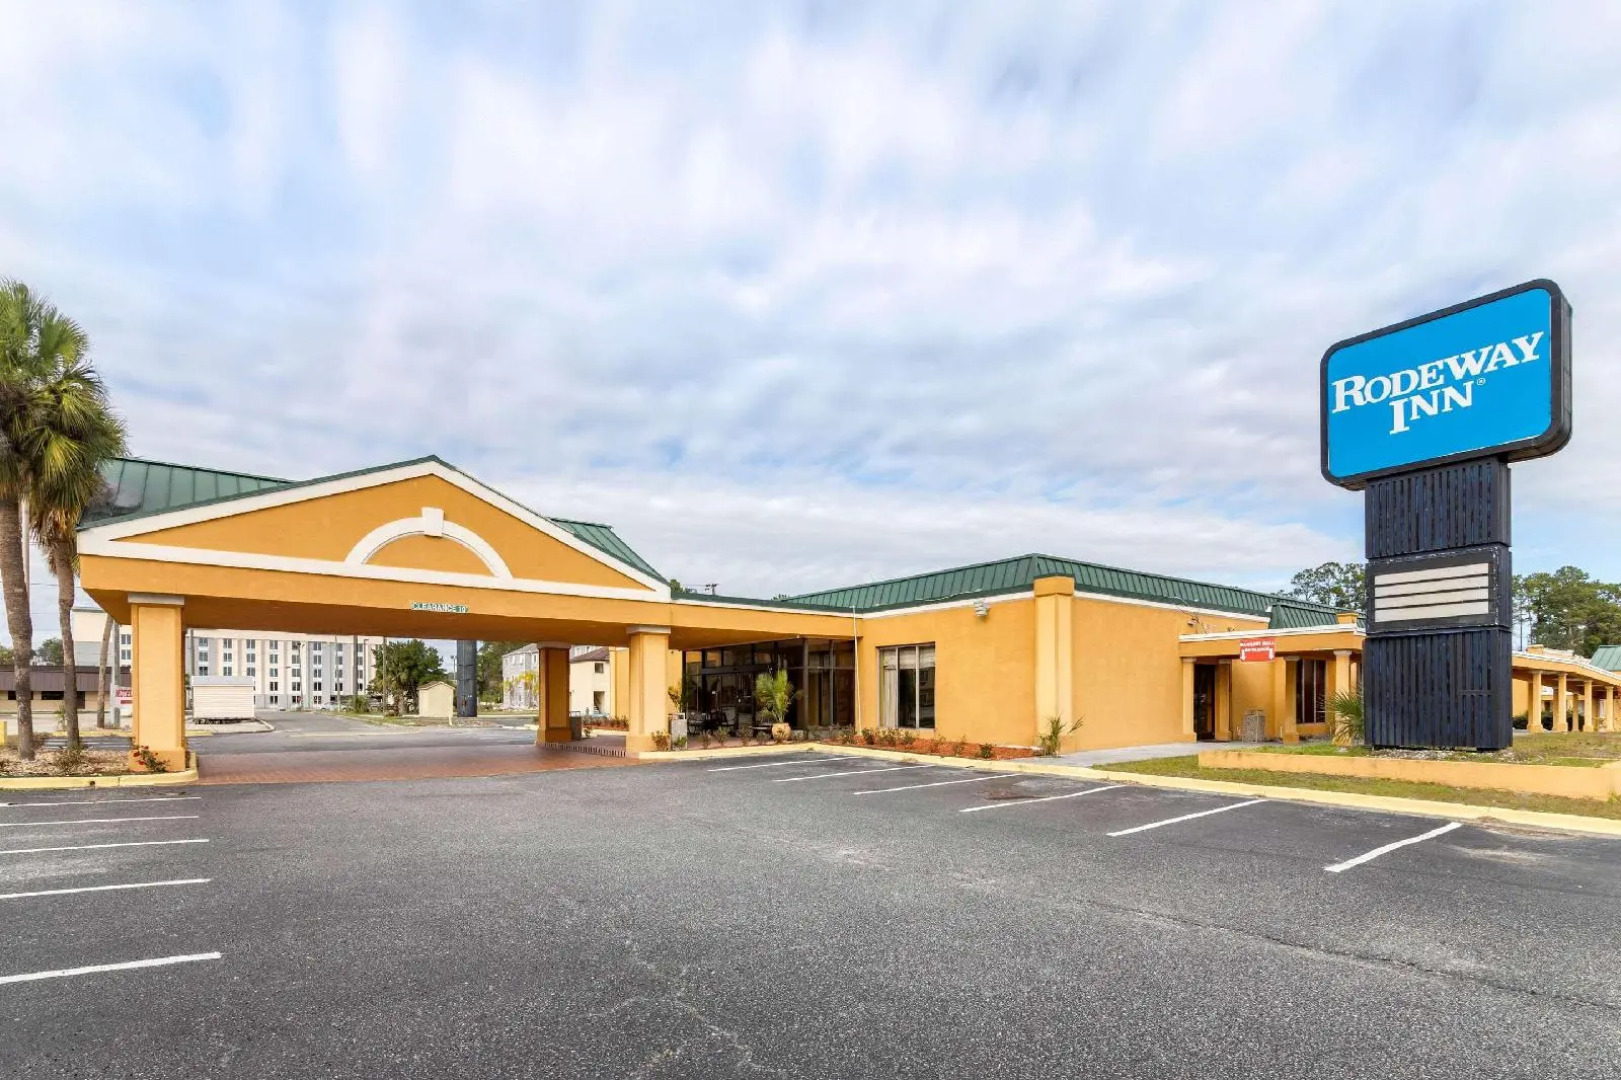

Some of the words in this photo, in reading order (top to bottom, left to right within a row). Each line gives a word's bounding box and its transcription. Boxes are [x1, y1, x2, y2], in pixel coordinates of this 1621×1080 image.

[1331, 331, 1544, 413] RODEWAY
[1389, 380, 1475, 435] INN
[411, 602, 457, 613] CLEARANCE
